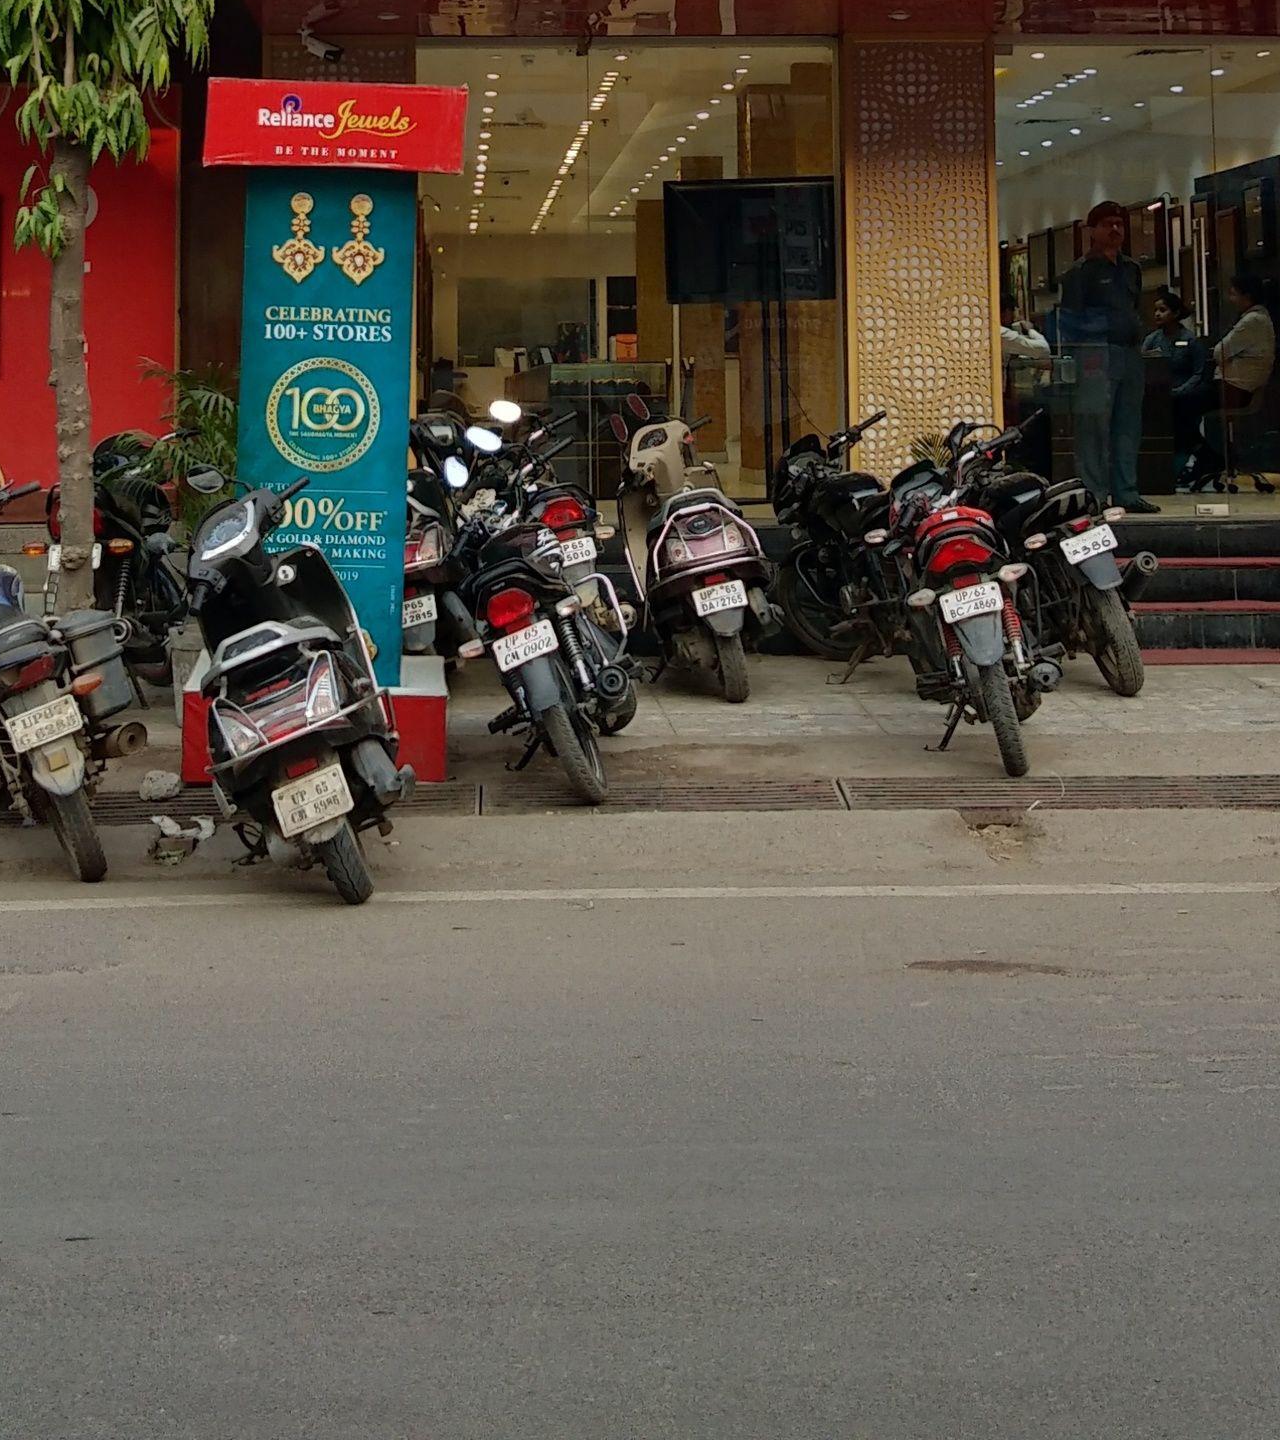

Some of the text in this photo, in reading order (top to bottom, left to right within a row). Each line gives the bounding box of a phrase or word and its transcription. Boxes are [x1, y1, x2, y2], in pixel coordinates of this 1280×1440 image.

[258, 99, 417, 139] Reliance Jewels
[275, 146, 398, 159] BE THE MOMENT
[265, 306, 391, 323] CELEBRATING
[264, 323, 392, 342] 100+ STORES
[285, 387, 365, 431] 100
[276, 534, 385, 545] GOLD & DIAMOND
[331, 548, 386, 559] MAKING
[505, 626, 538, 649] UP 65
[504, 636, 552, 665] CM 0902
